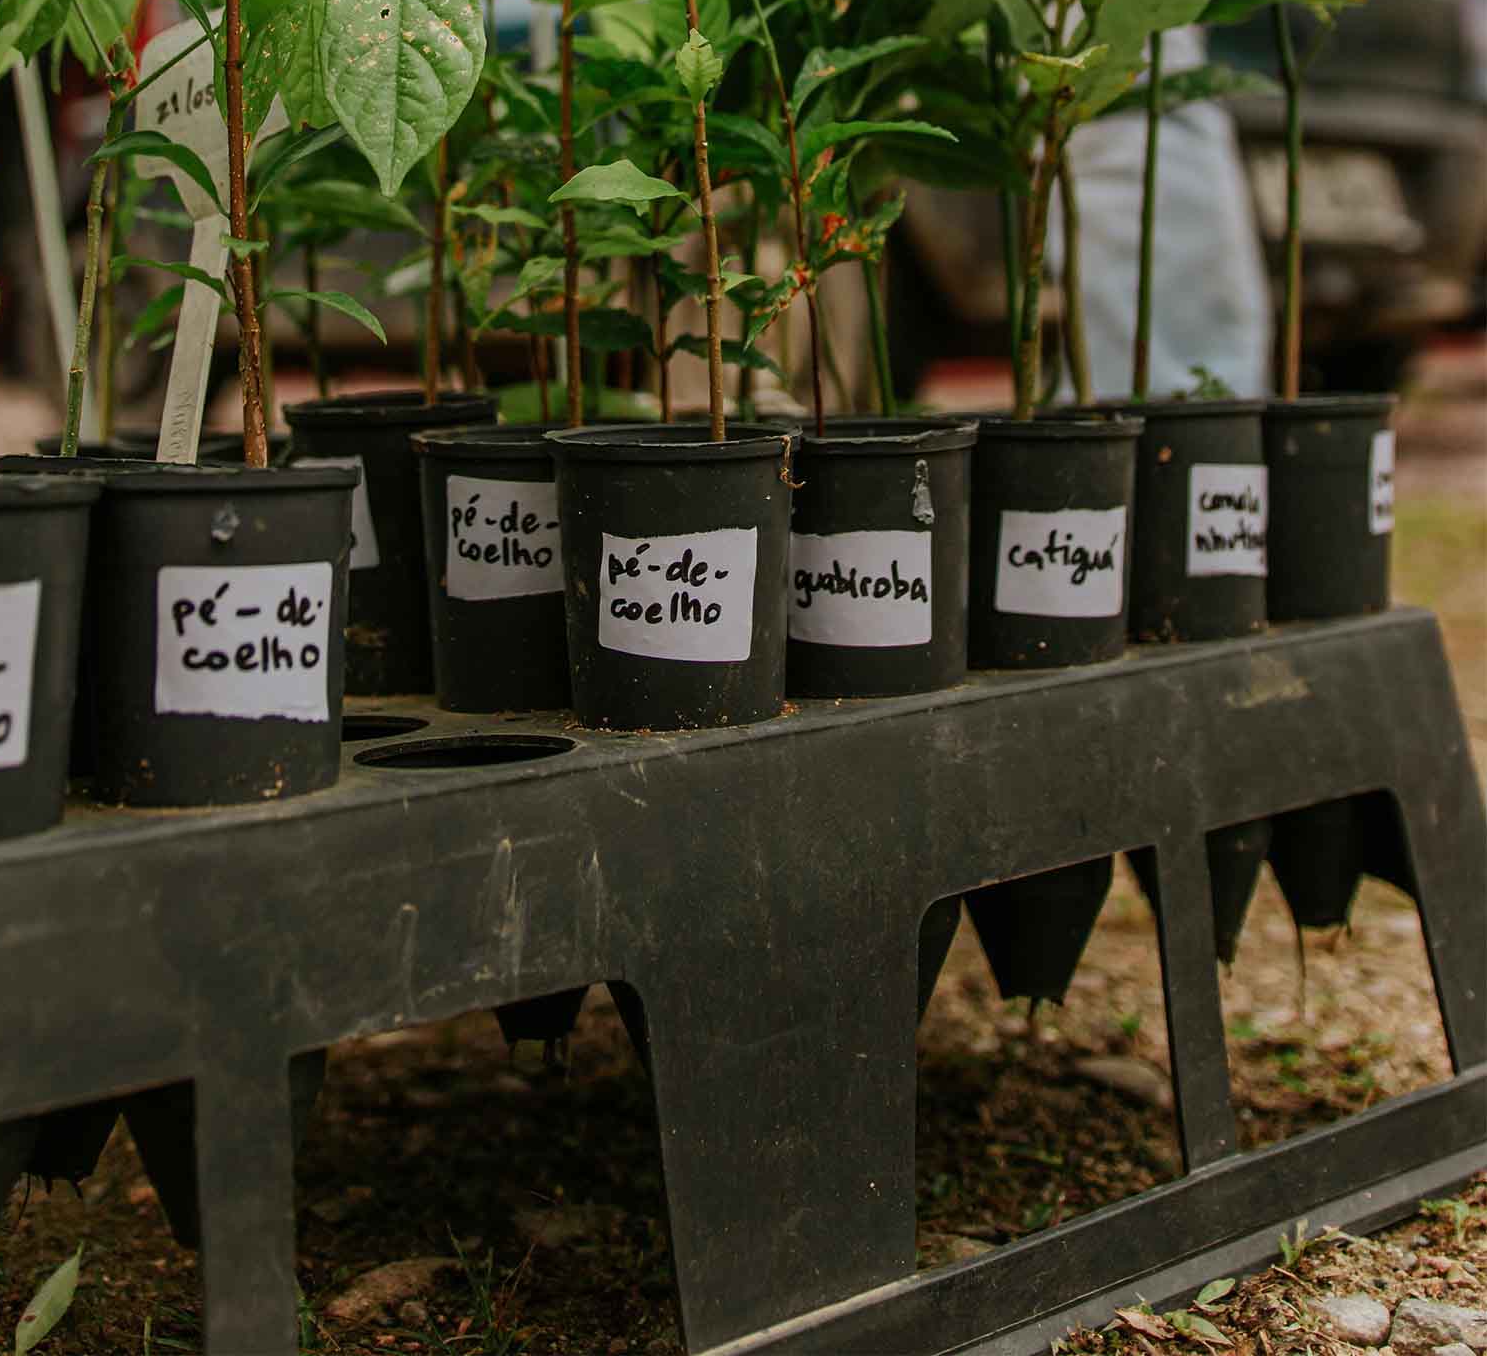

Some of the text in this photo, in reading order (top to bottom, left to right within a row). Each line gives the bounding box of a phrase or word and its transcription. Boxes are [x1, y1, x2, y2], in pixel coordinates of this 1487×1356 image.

[457, 536, 554, 568] coelho
[1007, 530, 1120, 587] catiguá
[794, 560, 929, 608] guabiroba
[610, 591, 722, 626] coelho
[182, 637, 321, 673] coelho
